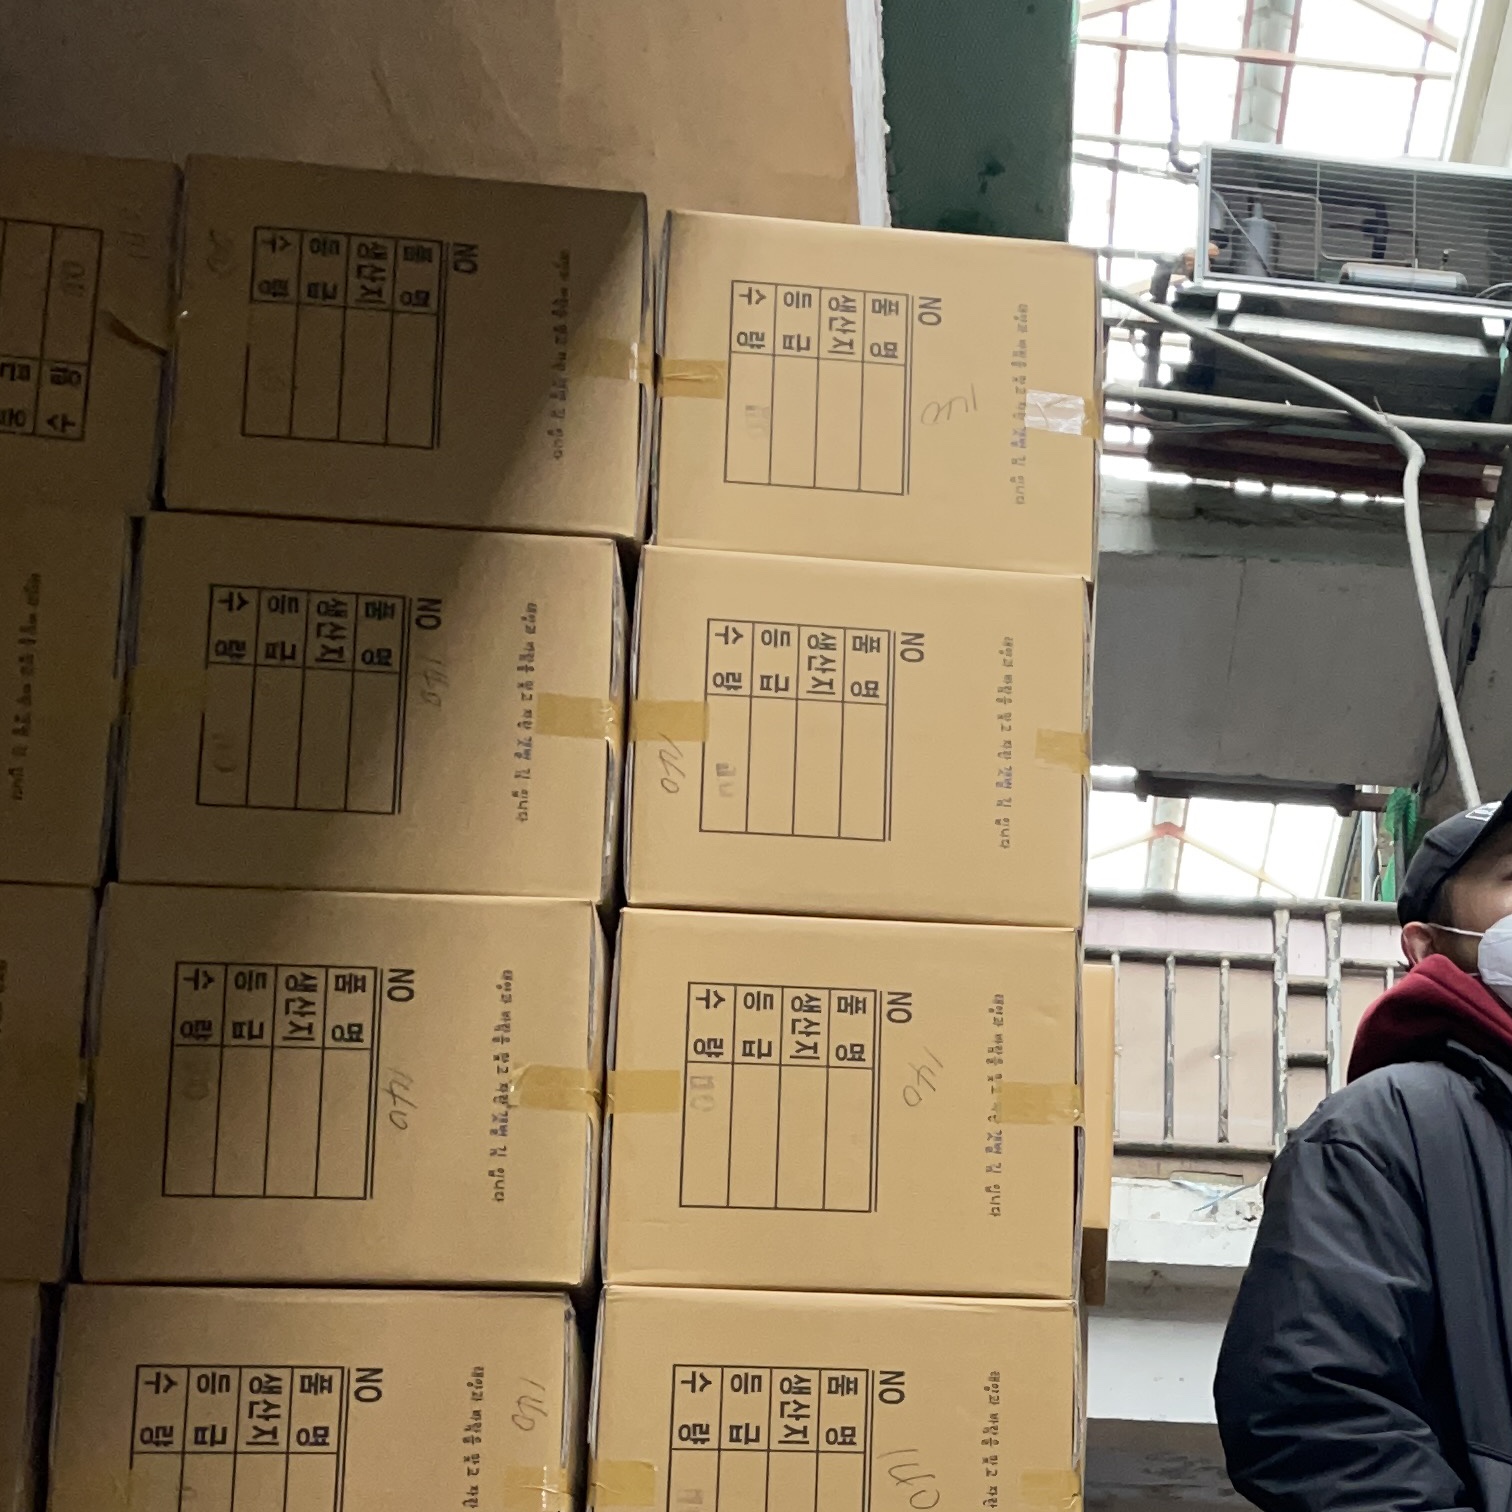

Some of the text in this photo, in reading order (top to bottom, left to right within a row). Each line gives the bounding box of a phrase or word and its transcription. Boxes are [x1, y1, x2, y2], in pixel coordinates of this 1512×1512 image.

[827, 294, 857, 356] 생산지
[917, 296, 942, 327] NO
[414, 597, 443, 631] NO
[806, 631, 837, 696] 생산지
[899, 631, 925, 663] NO
[282, 971, 318, 1042] 생산지
[386, 968, 416, 1003] NO
[886, 991, 913, 1024] NO
[789, 993, 822, 1061] 생산지
[902, 1048, 945, 1109] 140
[353, 1367, 384, 1403] NO
[878, 1370, 906, 1405] NO
[245, 1373, 283, 1447] 생산지
[777, 1374, 812, 1445] 생산지
